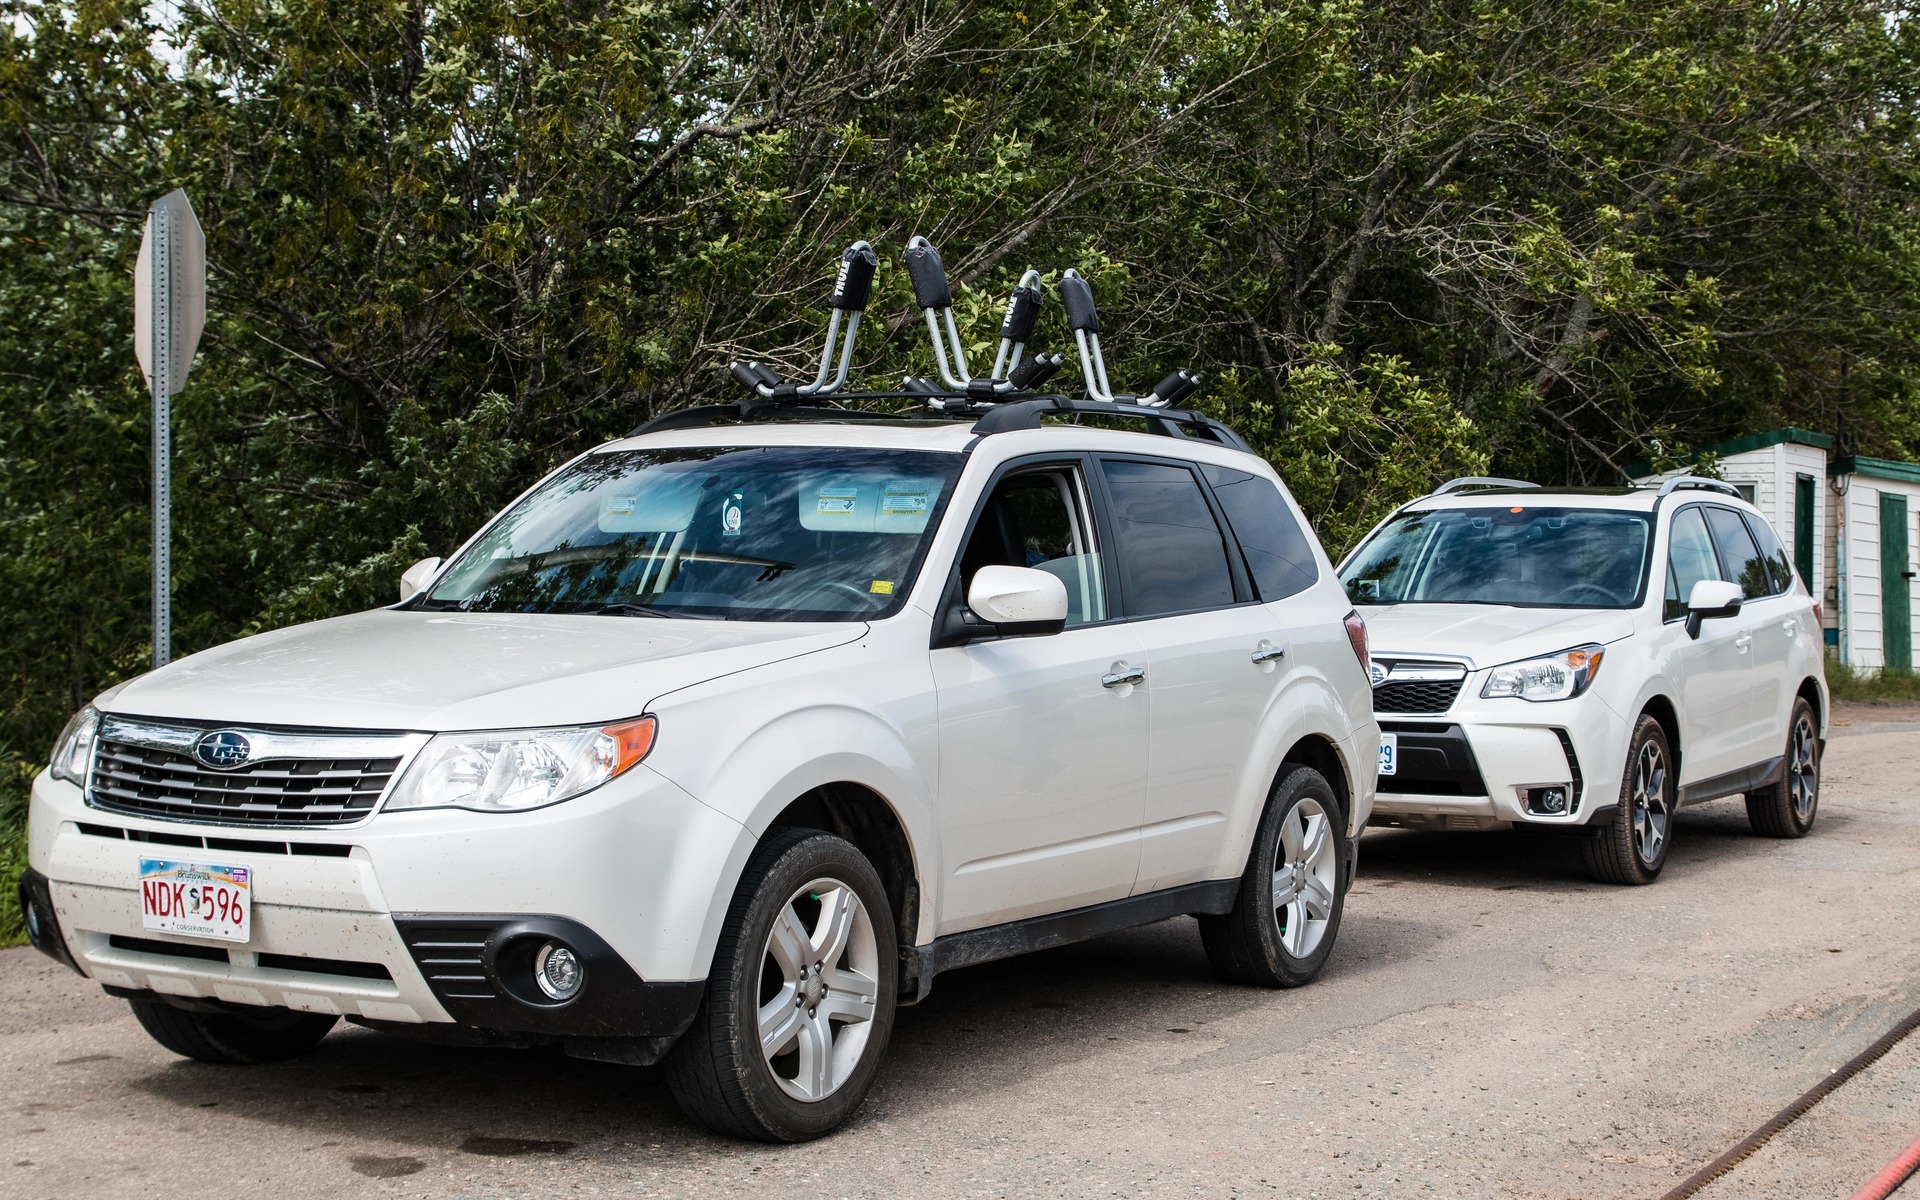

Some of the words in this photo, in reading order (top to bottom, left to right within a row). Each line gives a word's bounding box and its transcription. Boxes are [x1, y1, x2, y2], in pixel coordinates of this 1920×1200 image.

[833, 260, 851, 297] THULE
[1002, 296, 1018, 328] THULE
[177, 869, 212, 881] Brunswick
[143, 880, 187, 919] NDK
[202, 885, 243, 925] 596
[176, 924, 215, 934] CONSERVATION
